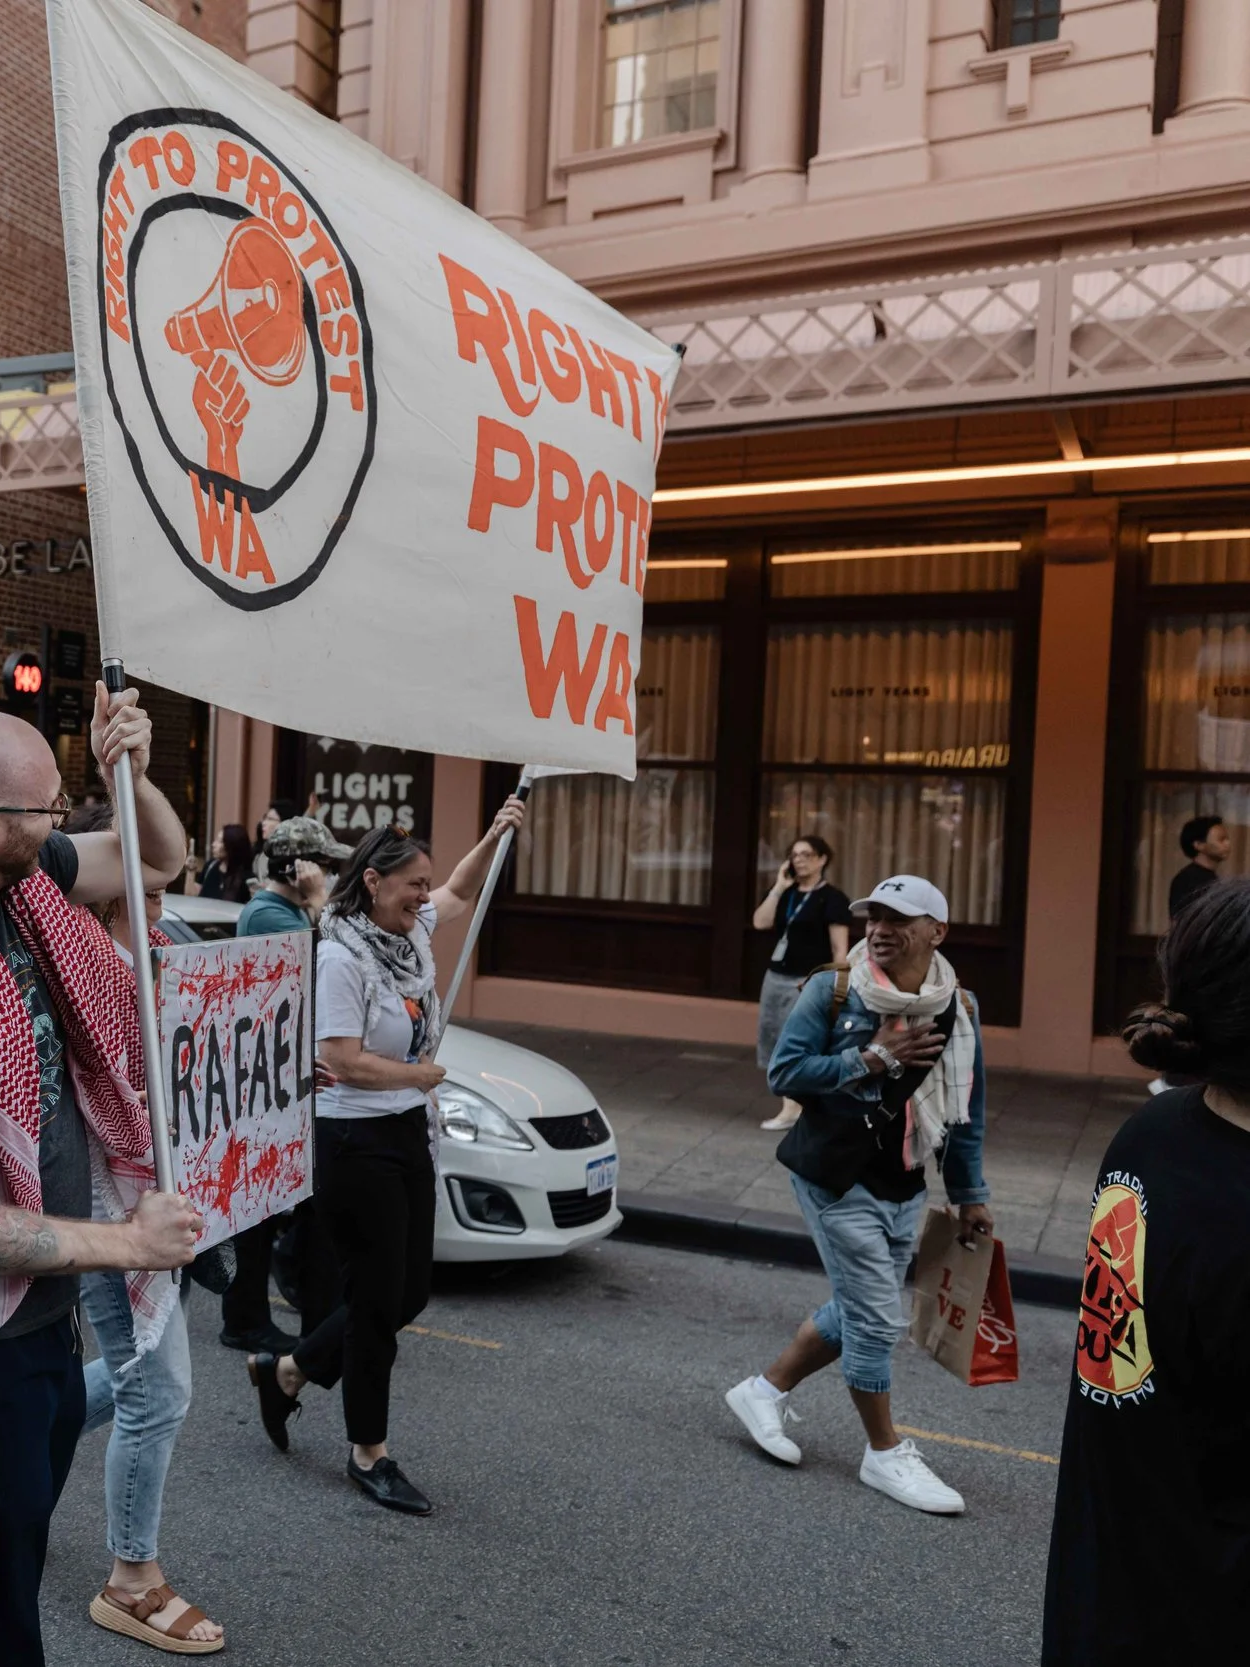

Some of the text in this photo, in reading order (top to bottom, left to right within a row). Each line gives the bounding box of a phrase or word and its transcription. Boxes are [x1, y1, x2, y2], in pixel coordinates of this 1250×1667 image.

[105, 130, 364, 413] RIGHT TO PROTEST
[438, 252, 643, 443] RIGHT
[46, 538, 92, 573] LA
[188, 469, 276, 584] WA
[467, 415, 650, 597] PROTE
[513, 594, 634, 736] WA
[315, 771, 414, 801] LIGHT
[315, 802, 415, 832] YEARS
[171, 995, 312, 1148] RAFAEL
